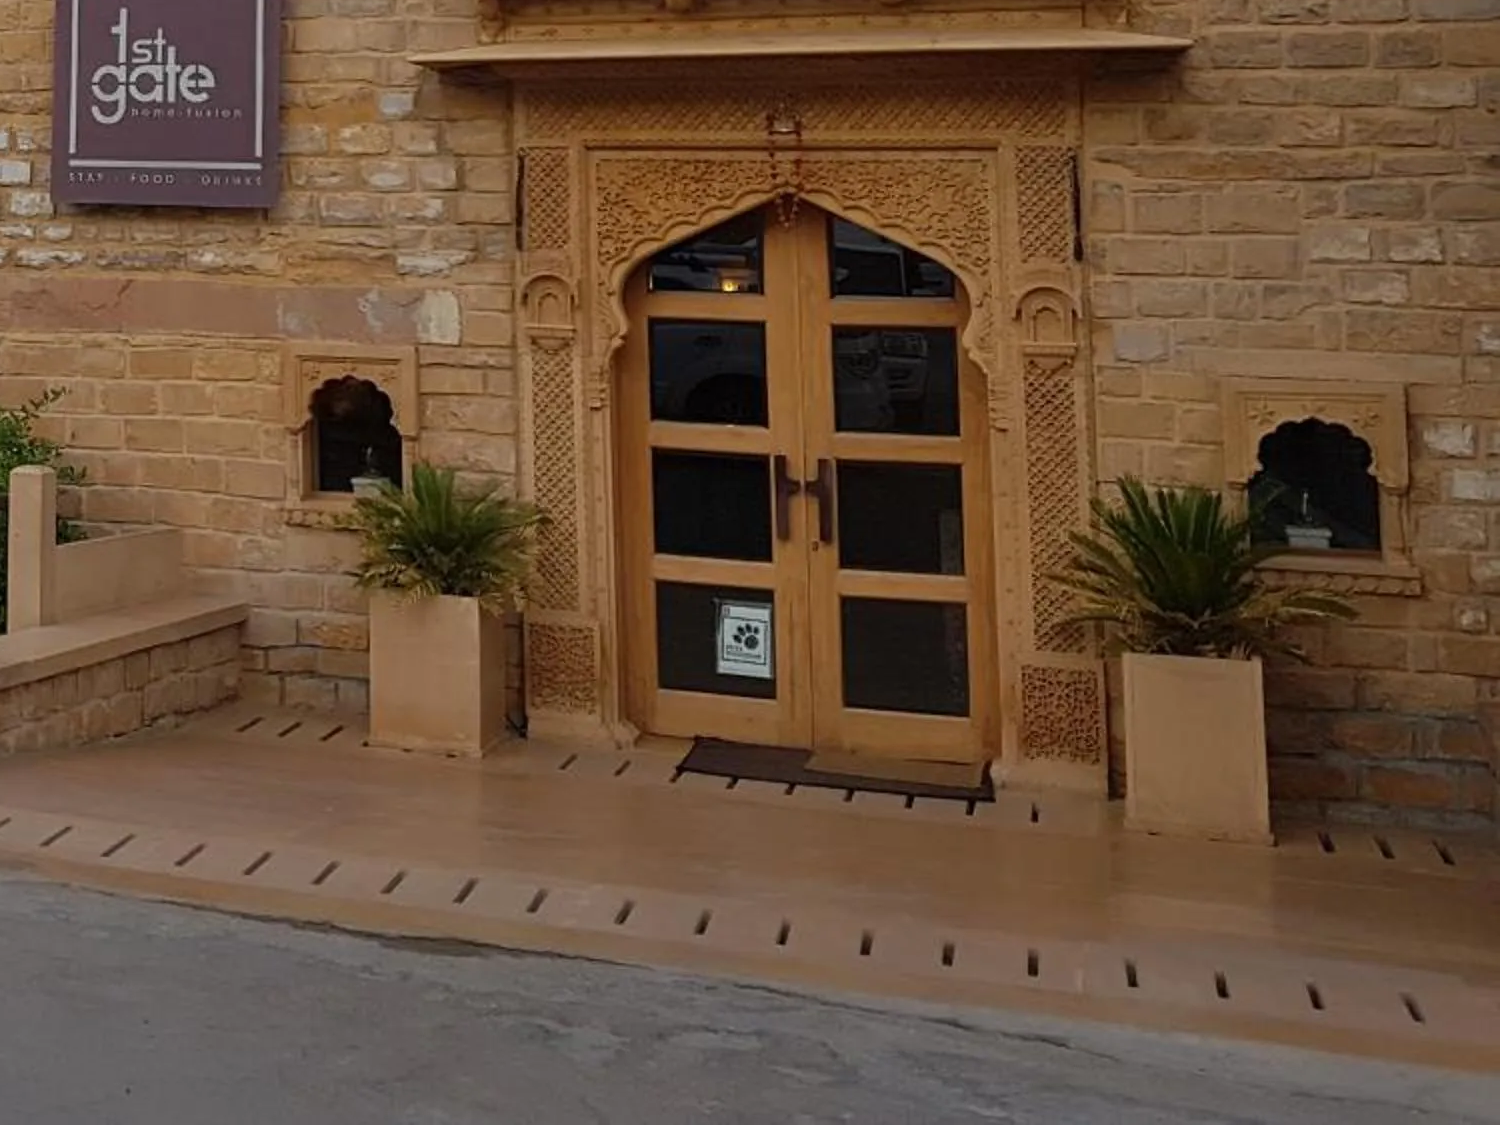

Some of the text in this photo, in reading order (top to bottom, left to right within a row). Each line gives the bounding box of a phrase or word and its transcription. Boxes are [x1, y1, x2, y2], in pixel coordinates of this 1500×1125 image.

[110, 7, 167, 63] 1st
[91, 46, 216, 124] gate
[131, 173, 176, 184] FOOD
